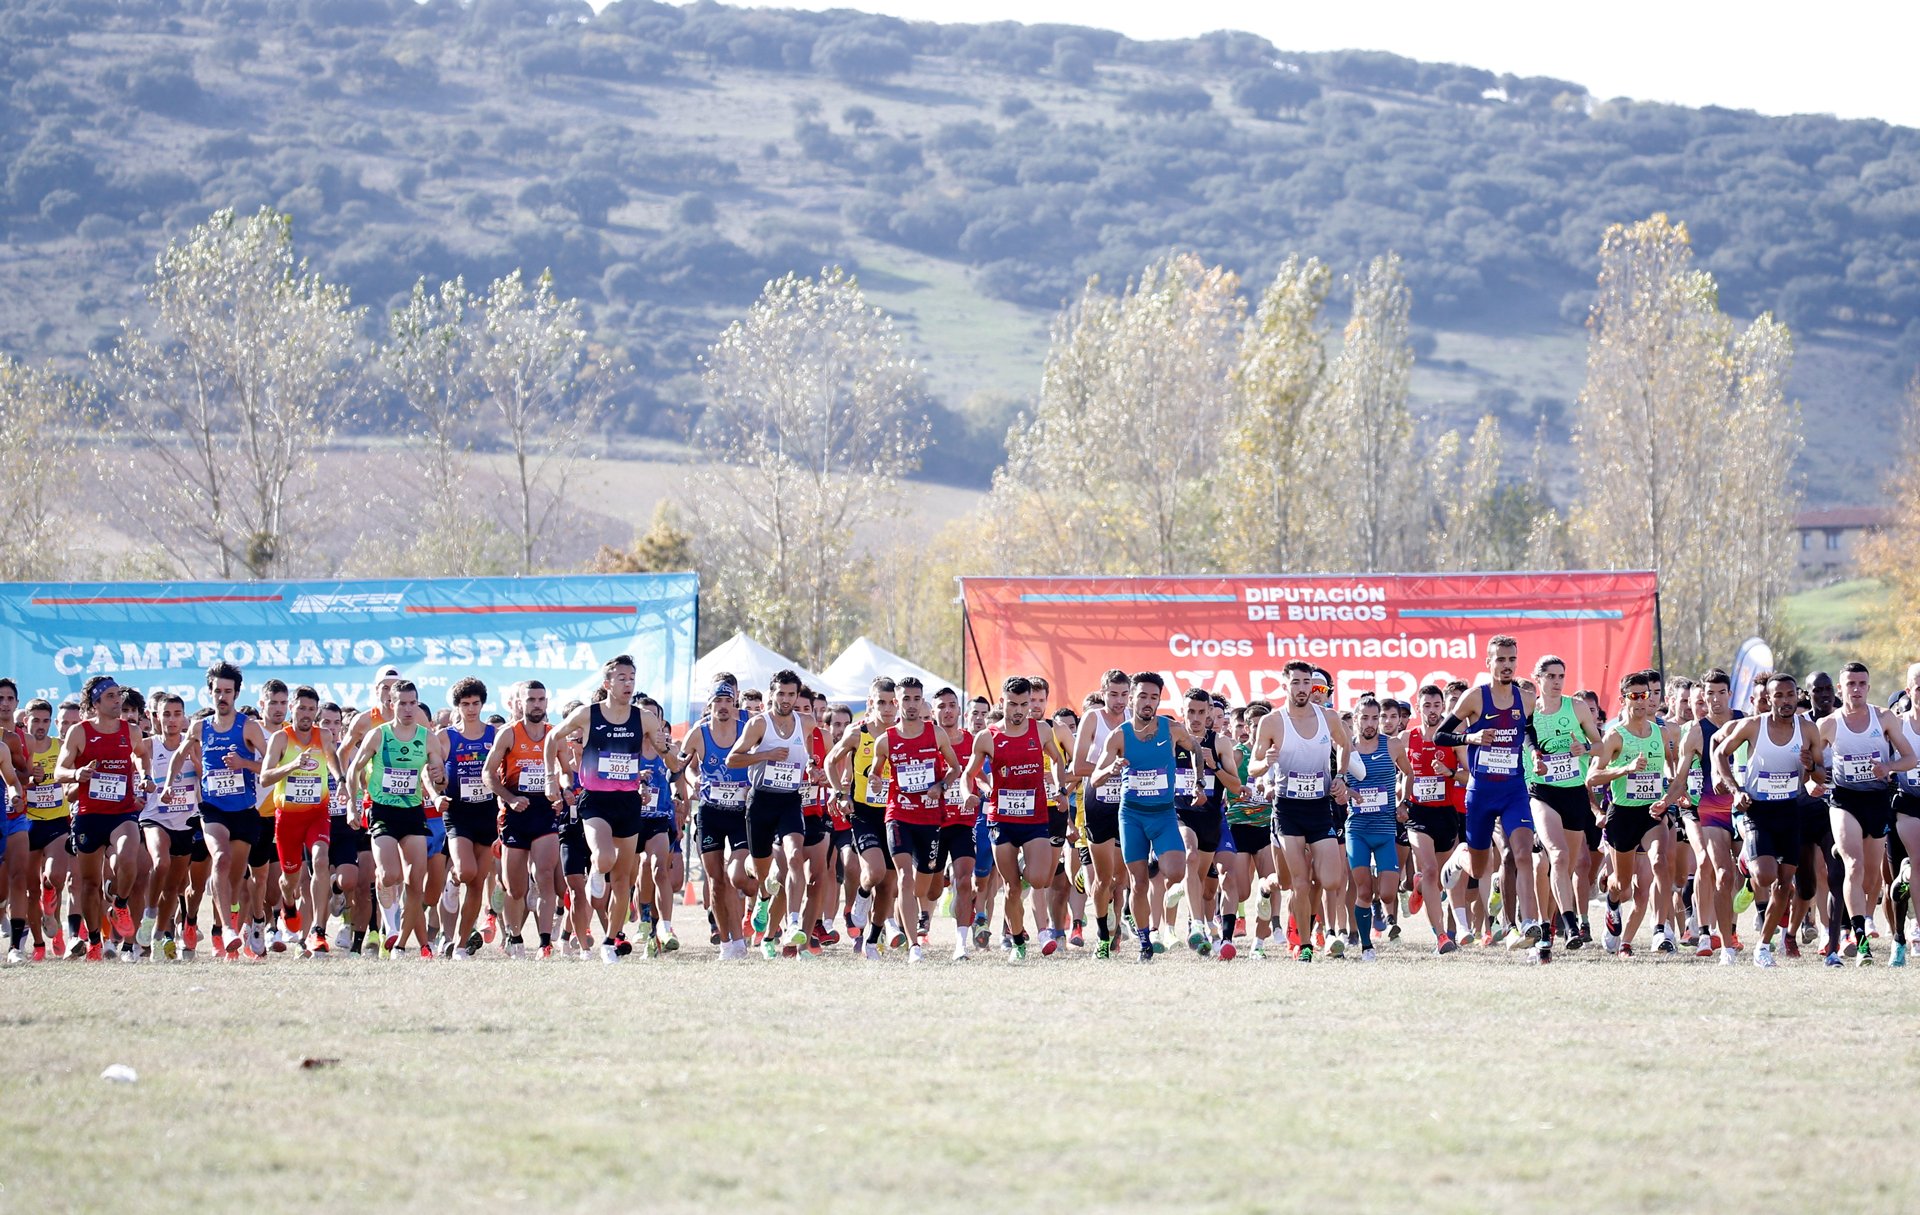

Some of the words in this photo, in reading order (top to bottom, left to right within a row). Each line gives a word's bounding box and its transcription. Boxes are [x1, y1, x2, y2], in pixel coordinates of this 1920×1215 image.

[1245, 586, 1386, 602] DIPUTACIÓN
[1249, 605, 1281, 621] DE
[1287, 604, 1387, 621] BURGOS
[1168, 632, 1253, 658] Cross
[1267, 632, 1476, 659] Internacional
[54, 638, 385, 676] CAMPEONATO
[390, 636, 416, 648] DE
[423, 634, 600, 671] ESPAÑA
[418, 675, 448, 689] por
[36, 687, 59, 699] DE
[1494, 727, 1518, 735] NDACIÓ
[610, 764, 630, 773] 3035
[1010, 763, 1040, 771] PUERTAS
[1553, 764, 1572, 774] 203
[774, 773, 793, 782] 146
[908, 776, 926, 784] 117
[1551, 772, 1574, 781] Joma
[216, 779, 235, 788] 219
[391, 780, 410, 788] 300
[770, 780, 793, 788] Joma
[906, 783, 929, 792] Joma
[99, 785, 118, 793] 161
[216, 787, 238, 796] Joma
[472, 788, 483, 796] 81
[1421, 787, 1437, 795] 157
[36, 794, 55, 802] 3729
[95, 792, 118, 800] Joma
[167, 804, 189, 812] Joma
[1008, 801, 1026, 809] 164
